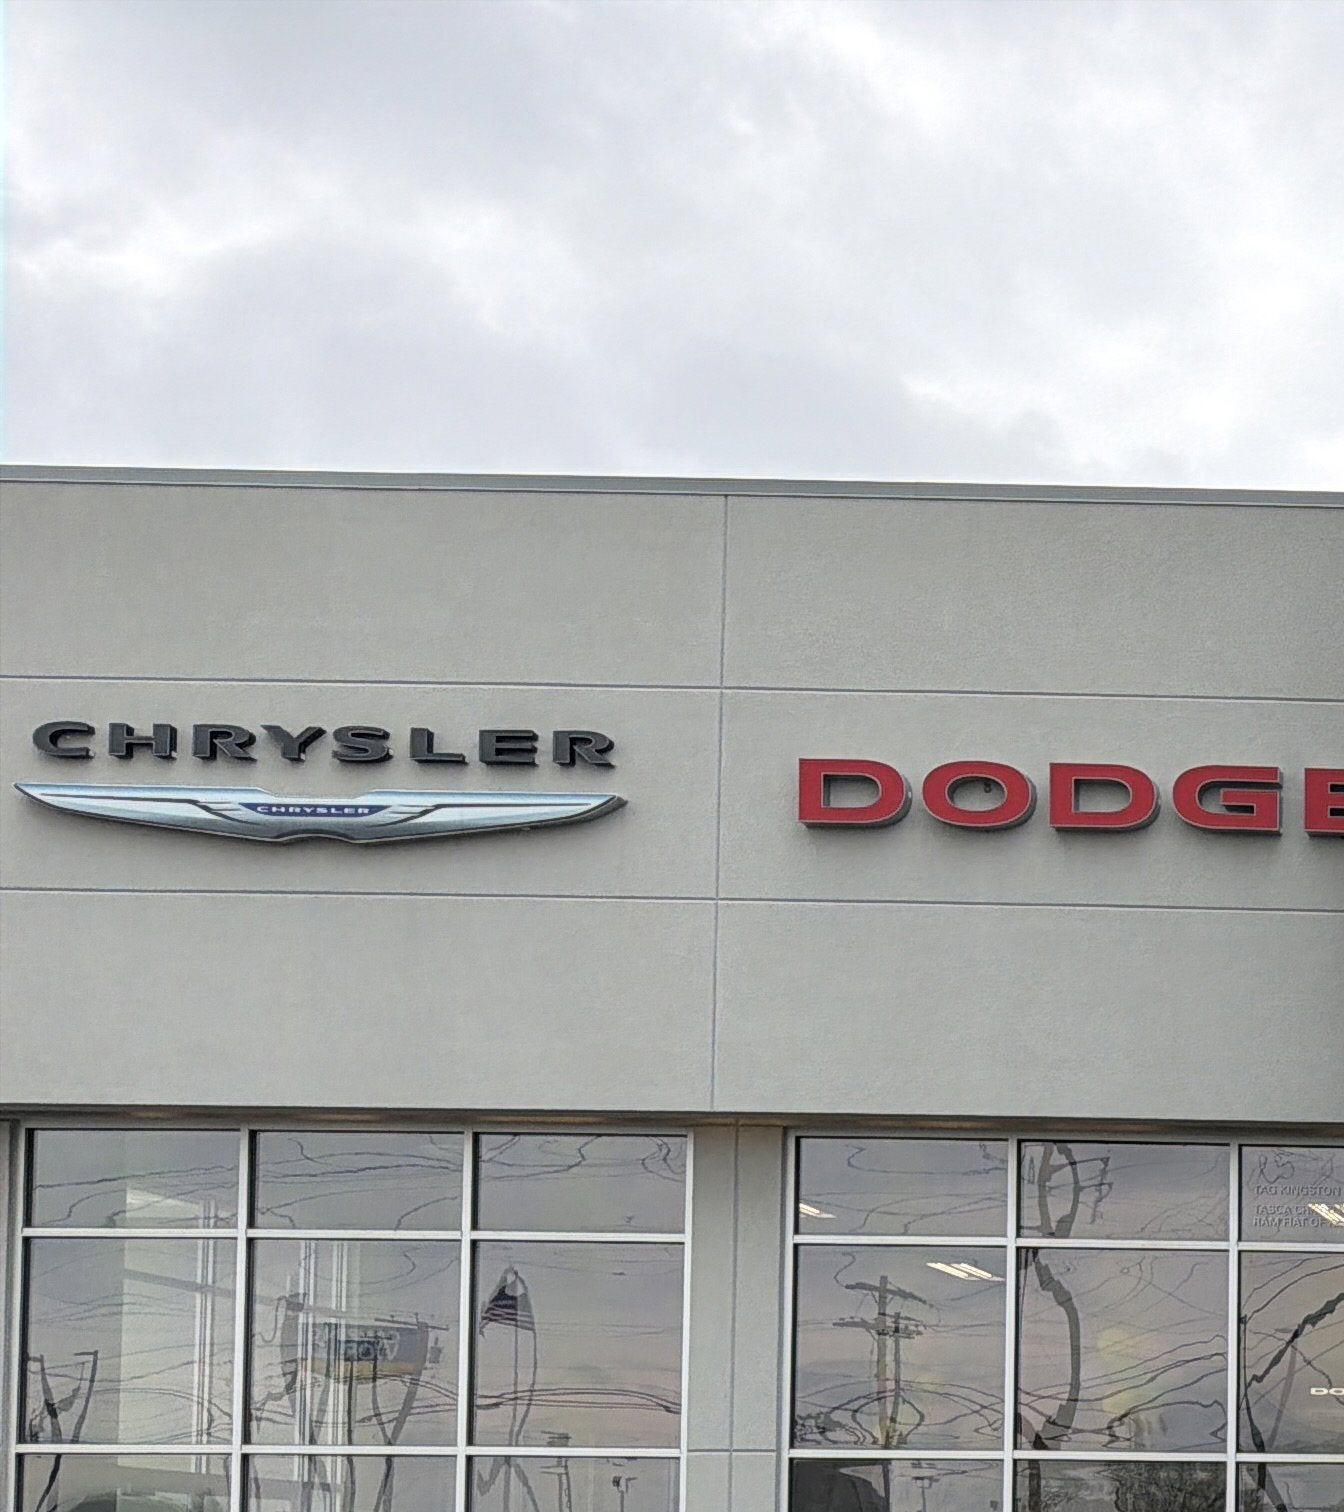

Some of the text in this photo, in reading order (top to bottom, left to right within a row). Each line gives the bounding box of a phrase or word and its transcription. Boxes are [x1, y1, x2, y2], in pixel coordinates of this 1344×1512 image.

[32, 720, 616, 767] CHRYSLER
[256, 806, 370, 815] CHRYSLER
[1281, 1185, 1341, 1197] KINGSTON
